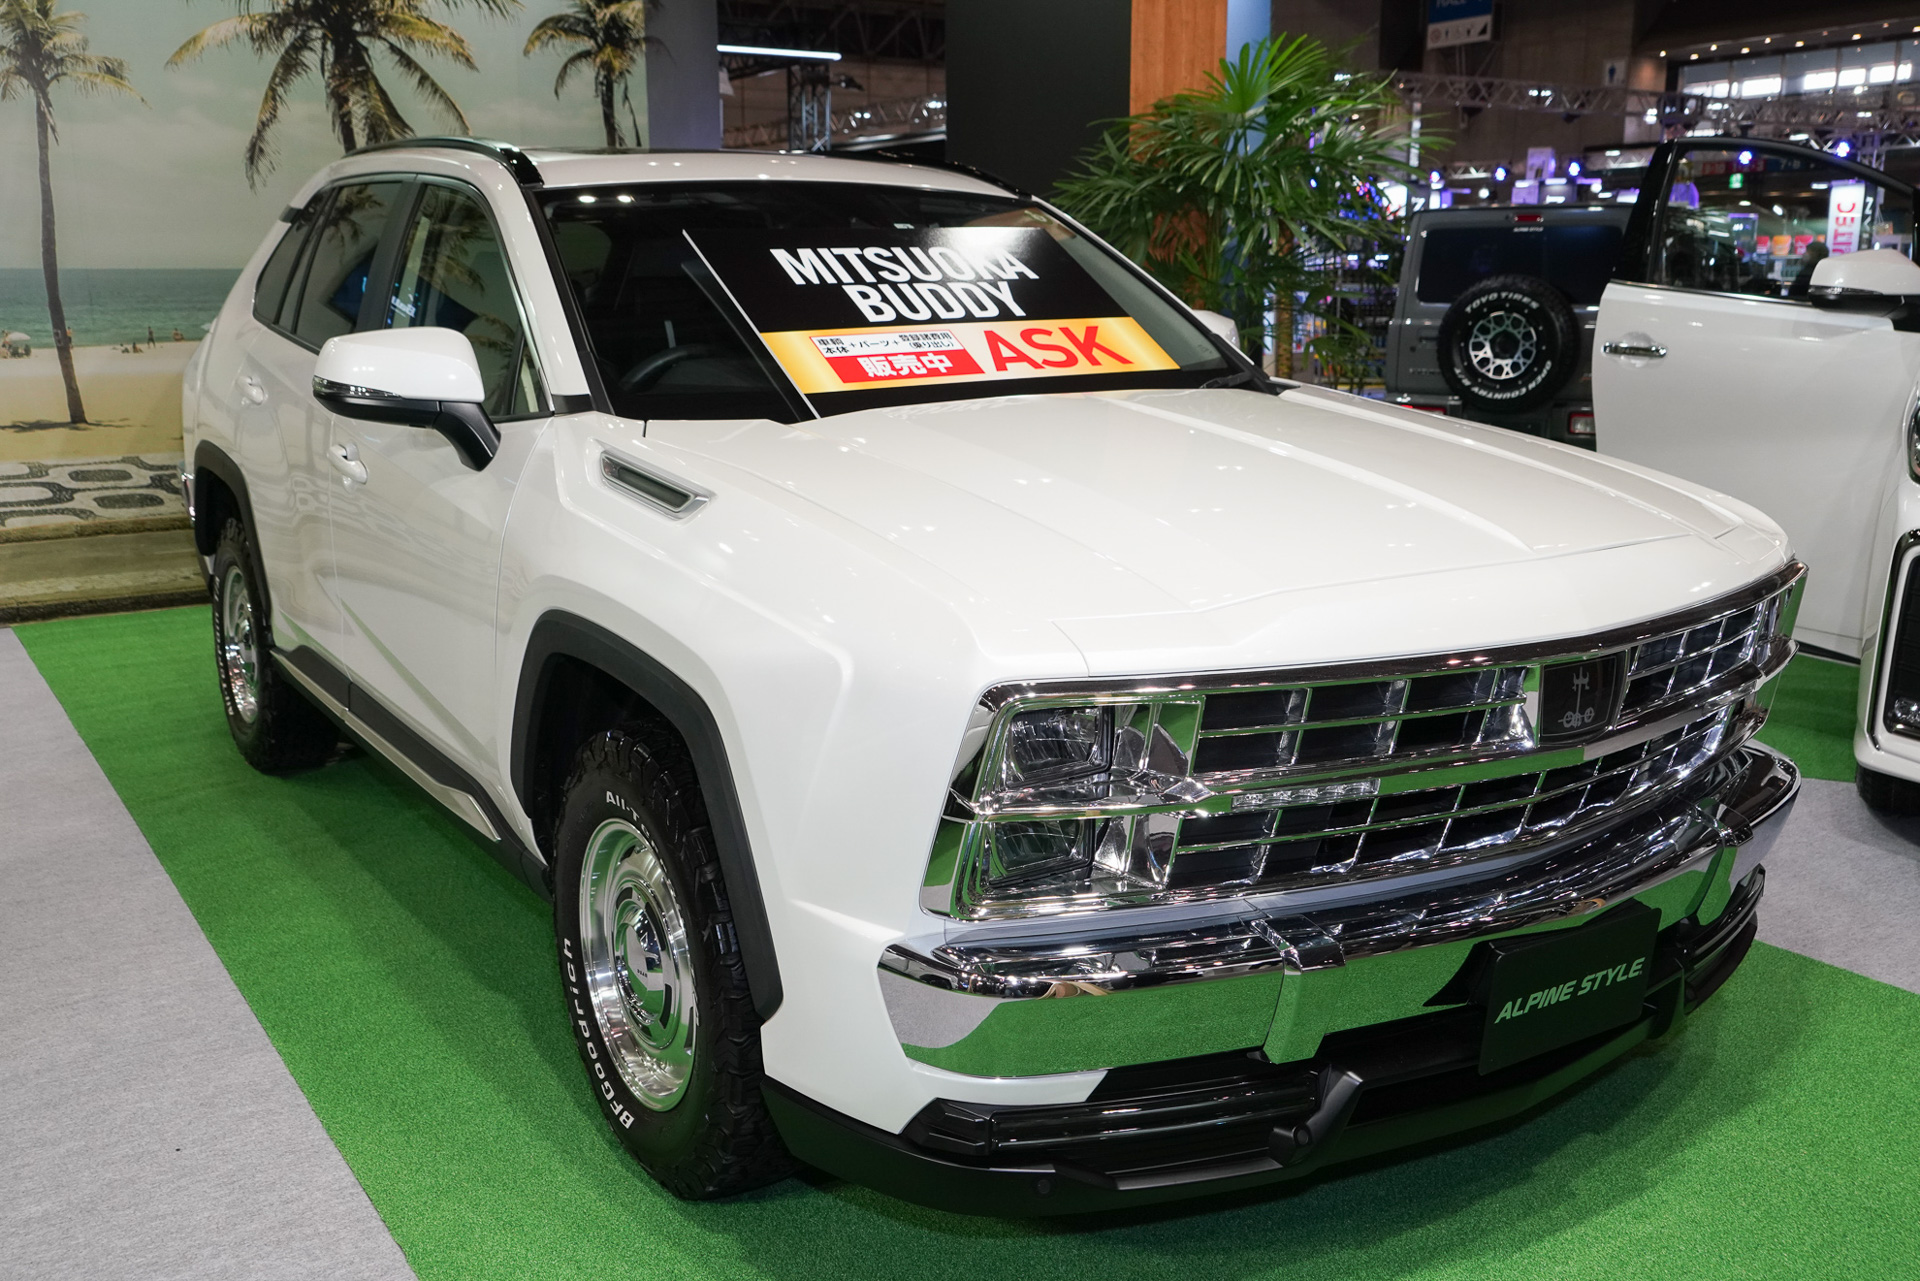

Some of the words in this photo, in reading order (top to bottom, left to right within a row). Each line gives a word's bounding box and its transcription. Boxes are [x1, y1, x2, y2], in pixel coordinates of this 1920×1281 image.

[769, 245, 1040, 285] MITSUOKA
[842, 281, 1027, 322] BUDDY
[1464, 292, 1498, 314] TOYO
[1499, 291, 1540, 310] TIRES
[825, 346, 850, 354] 本体
[857, 352, 953, 378] 販売中
[984, 326, 1134, 371] ASK
[1527, 359, 1552, 387] OPEN
[1470, 385, 1526, 400] COUNTRY
[1494, 979, 1577, 1024] ALPINE
[1577, 957, 1646, 996] STYLE
[563, 938, 635, 1129] BFGoodrich
